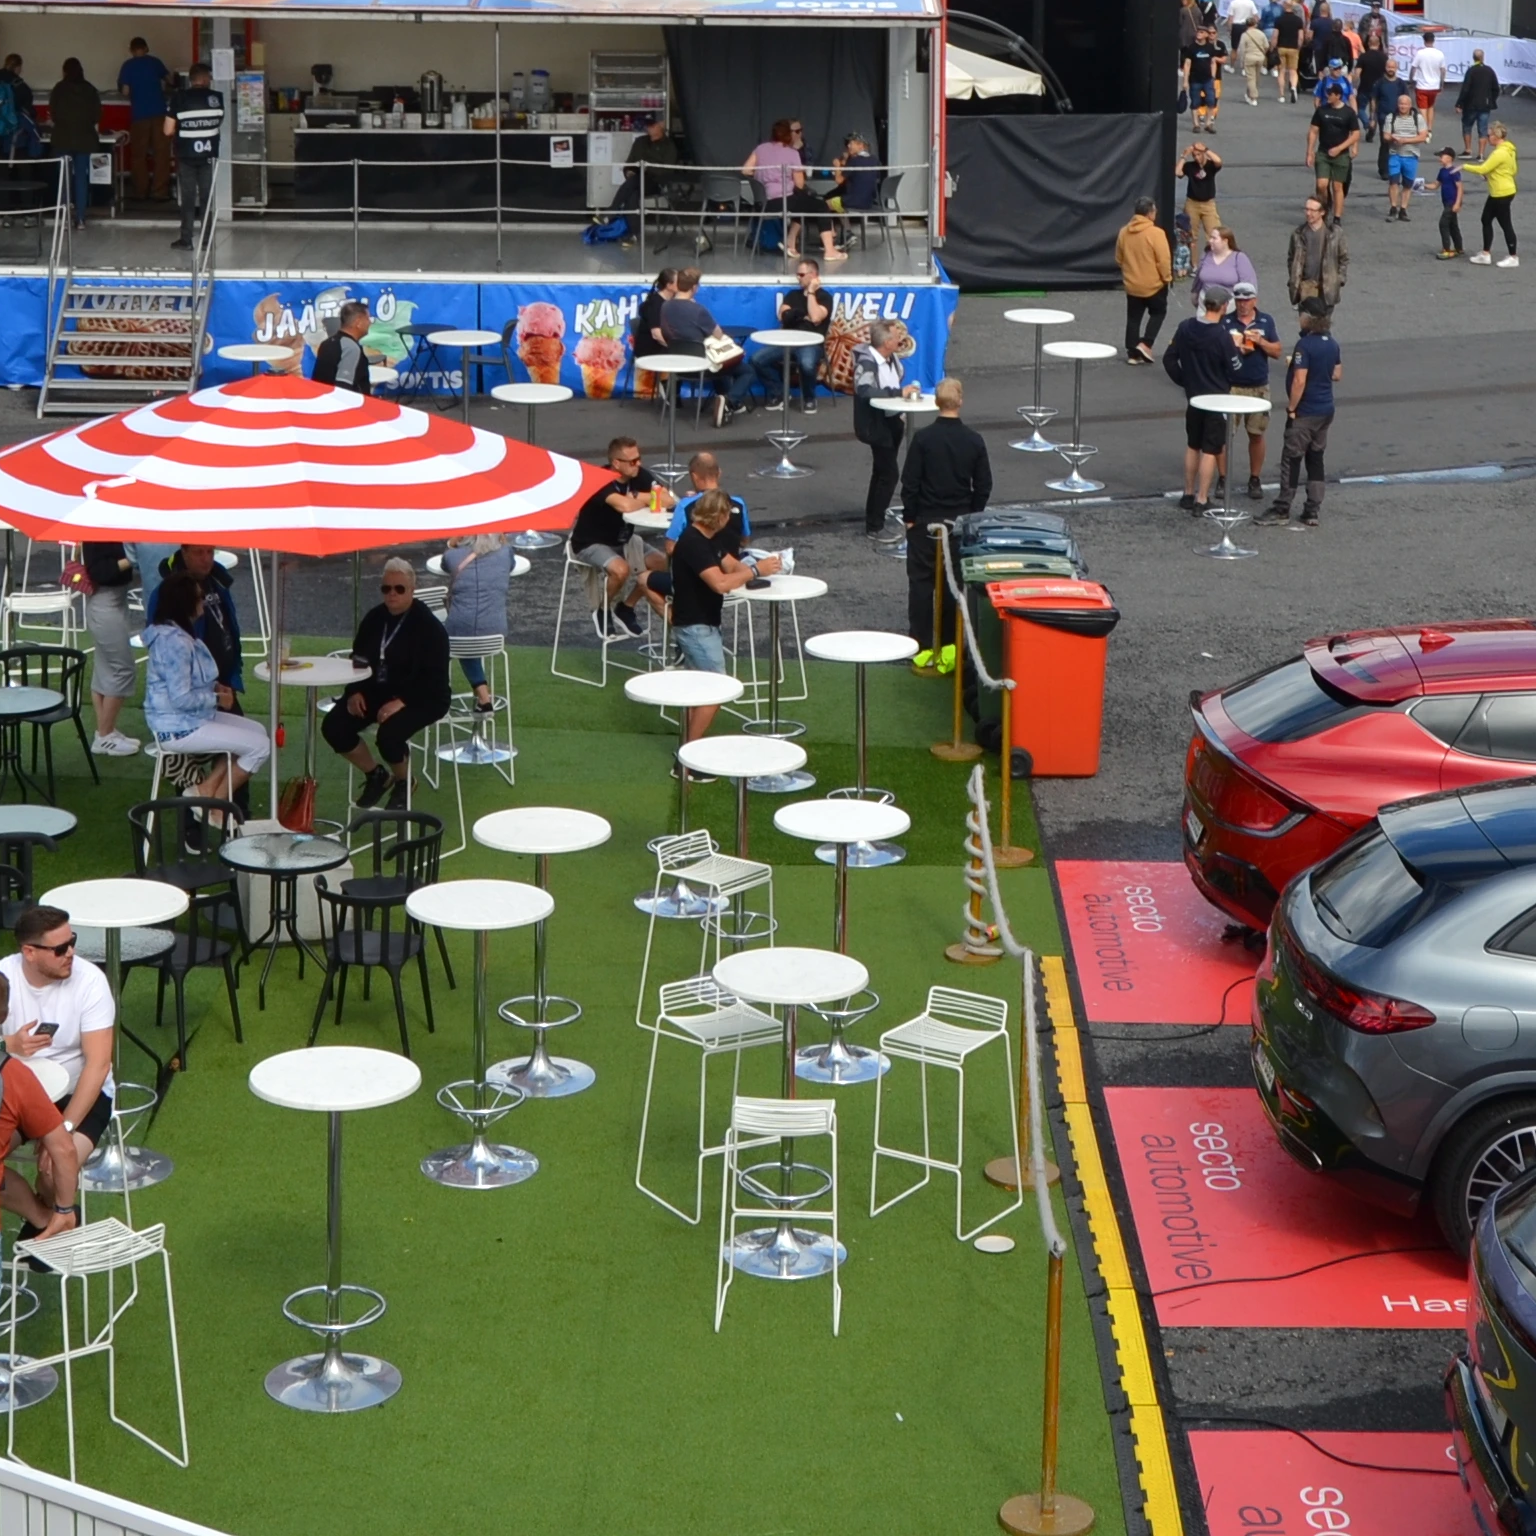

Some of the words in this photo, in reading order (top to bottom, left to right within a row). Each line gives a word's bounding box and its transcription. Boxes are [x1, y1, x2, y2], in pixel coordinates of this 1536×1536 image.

[775, 1, 897, 9] SOFTIS
[194, 140, 212, 153] 04
[387, 370, 463, 390] SOFTIS
[1124, 885, 1167, 932] secto
[1083, 893, 1135, 991] automotive
[1189, 1121, 1245, 1192] secto
[1141, 1133, 1217, 1280] automotive
